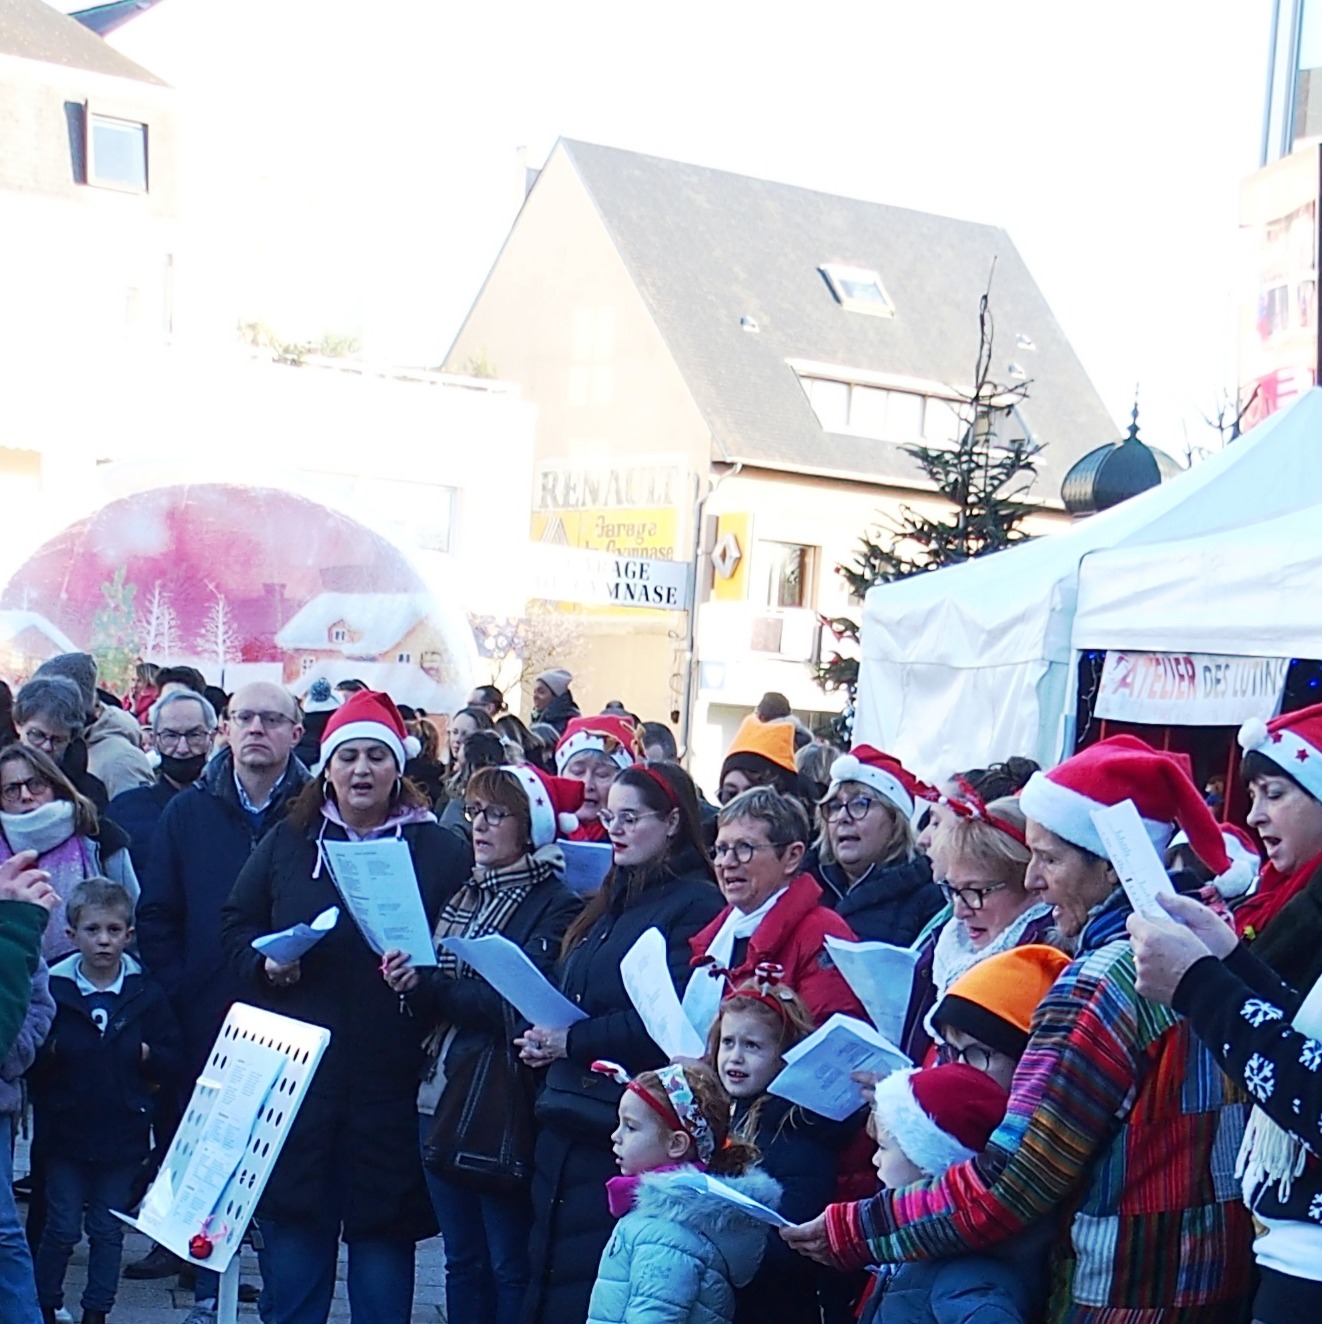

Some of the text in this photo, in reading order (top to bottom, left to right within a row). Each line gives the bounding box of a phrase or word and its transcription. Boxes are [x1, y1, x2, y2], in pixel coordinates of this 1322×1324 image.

[539, 467, 678, 509] RENAULT
[596, 515, 657, 545] Garage
[1203, 663, 1230, 699] DES
